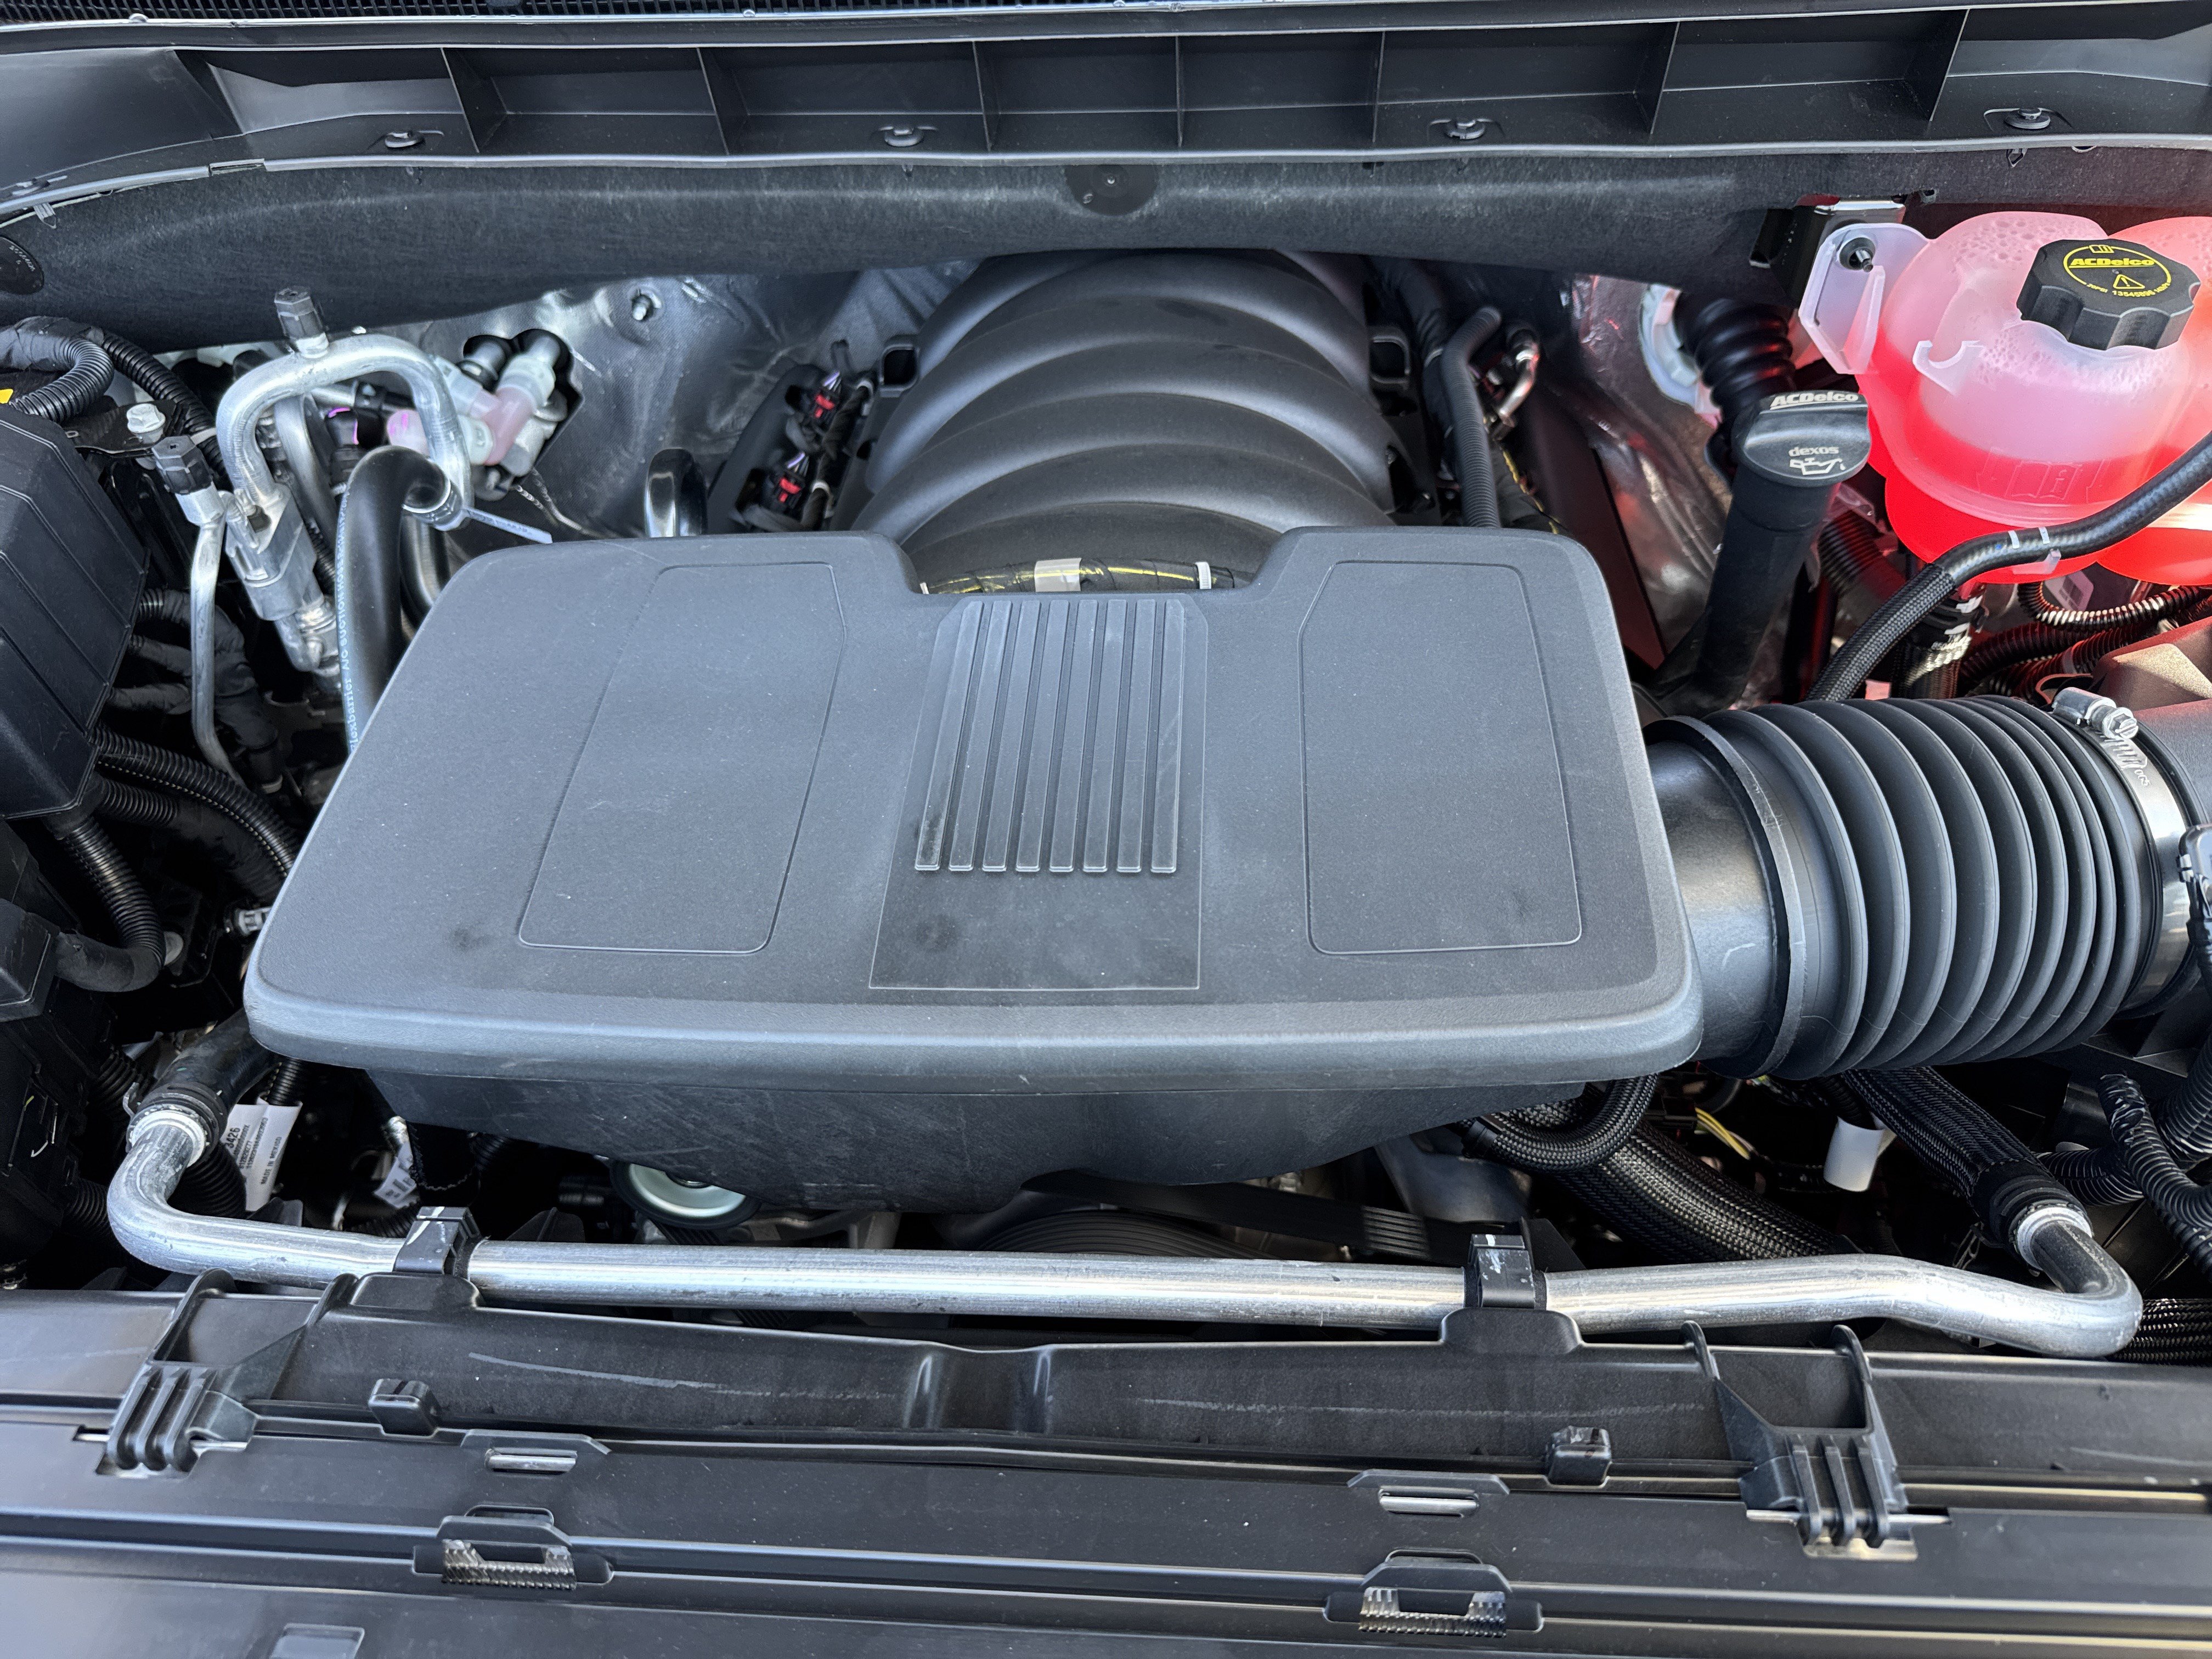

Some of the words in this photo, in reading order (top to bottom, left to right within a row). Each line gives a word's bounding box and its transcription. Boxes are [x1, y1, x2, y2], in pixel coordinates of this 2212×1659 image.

[1770, 392, 1859, 407] ACDelco
[1788, 446, 1839, 457] dexos
[337, 592, 347, 646] SUCTION
[261, 1169, 272, 1184] MADE
[270, 1137, 283, 1159] MEXICO
